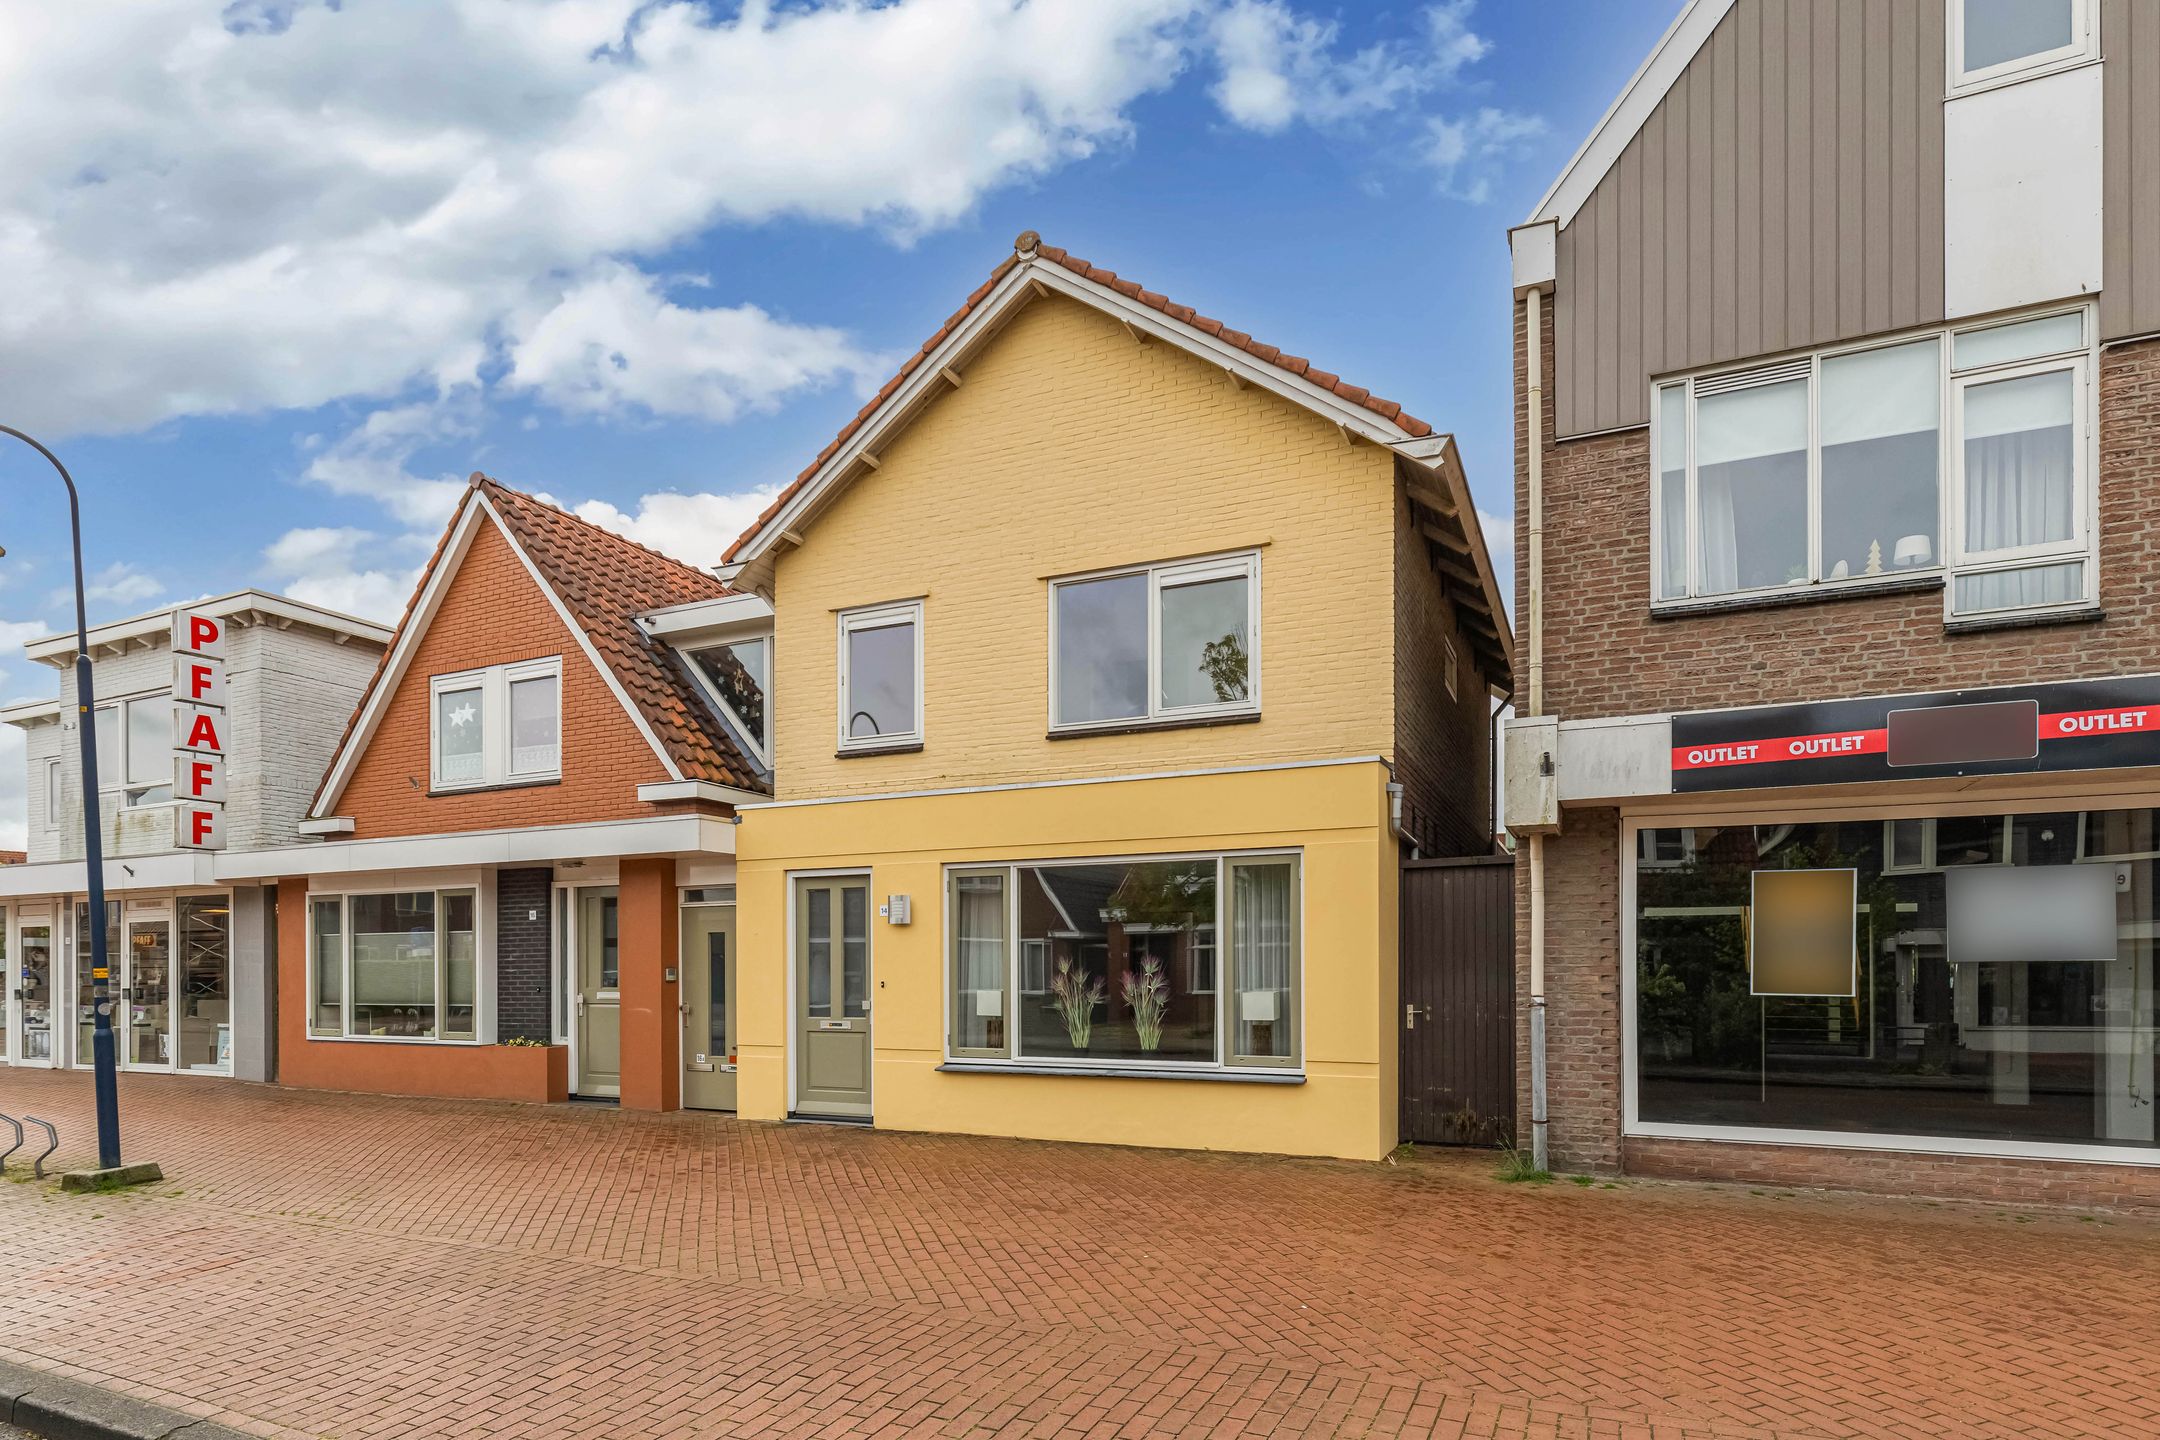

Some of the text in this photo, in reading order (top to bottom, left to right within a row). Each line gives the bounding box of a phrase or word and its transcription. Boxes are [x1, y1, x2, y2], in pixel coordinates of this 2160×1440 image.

[187, 615, 221, 845] PFAFF
[1688, 711, 2147, 764] OUTLET OUTLET OUTLET
